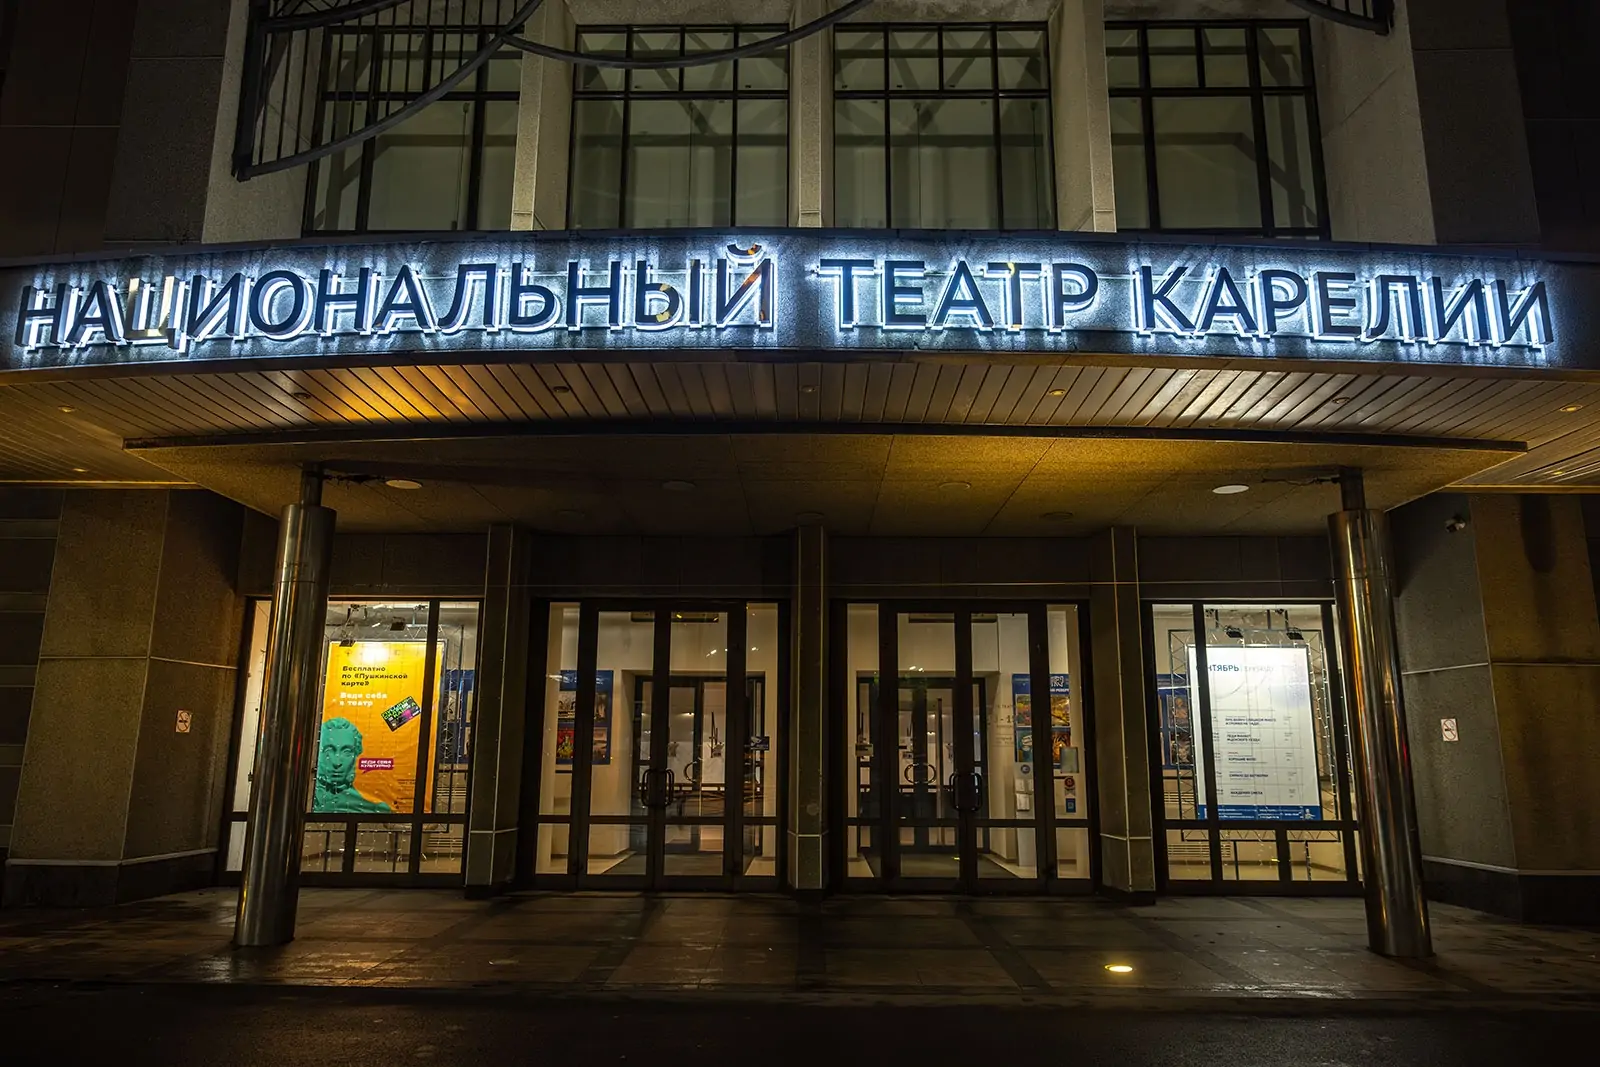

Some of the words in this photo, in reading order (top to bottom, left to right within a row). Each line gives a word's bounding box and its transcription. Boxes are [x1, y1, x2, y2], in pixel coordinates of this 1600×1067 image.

[14, 244, 776, 351] НАЦИОНАЛЬНЫЙ
[819, 259, 1099, 330] ТЕАТР
[1138, 264, 1555, 345] КАРЕЛИИ
[354, 672, 408, 680] «Пушкинской
